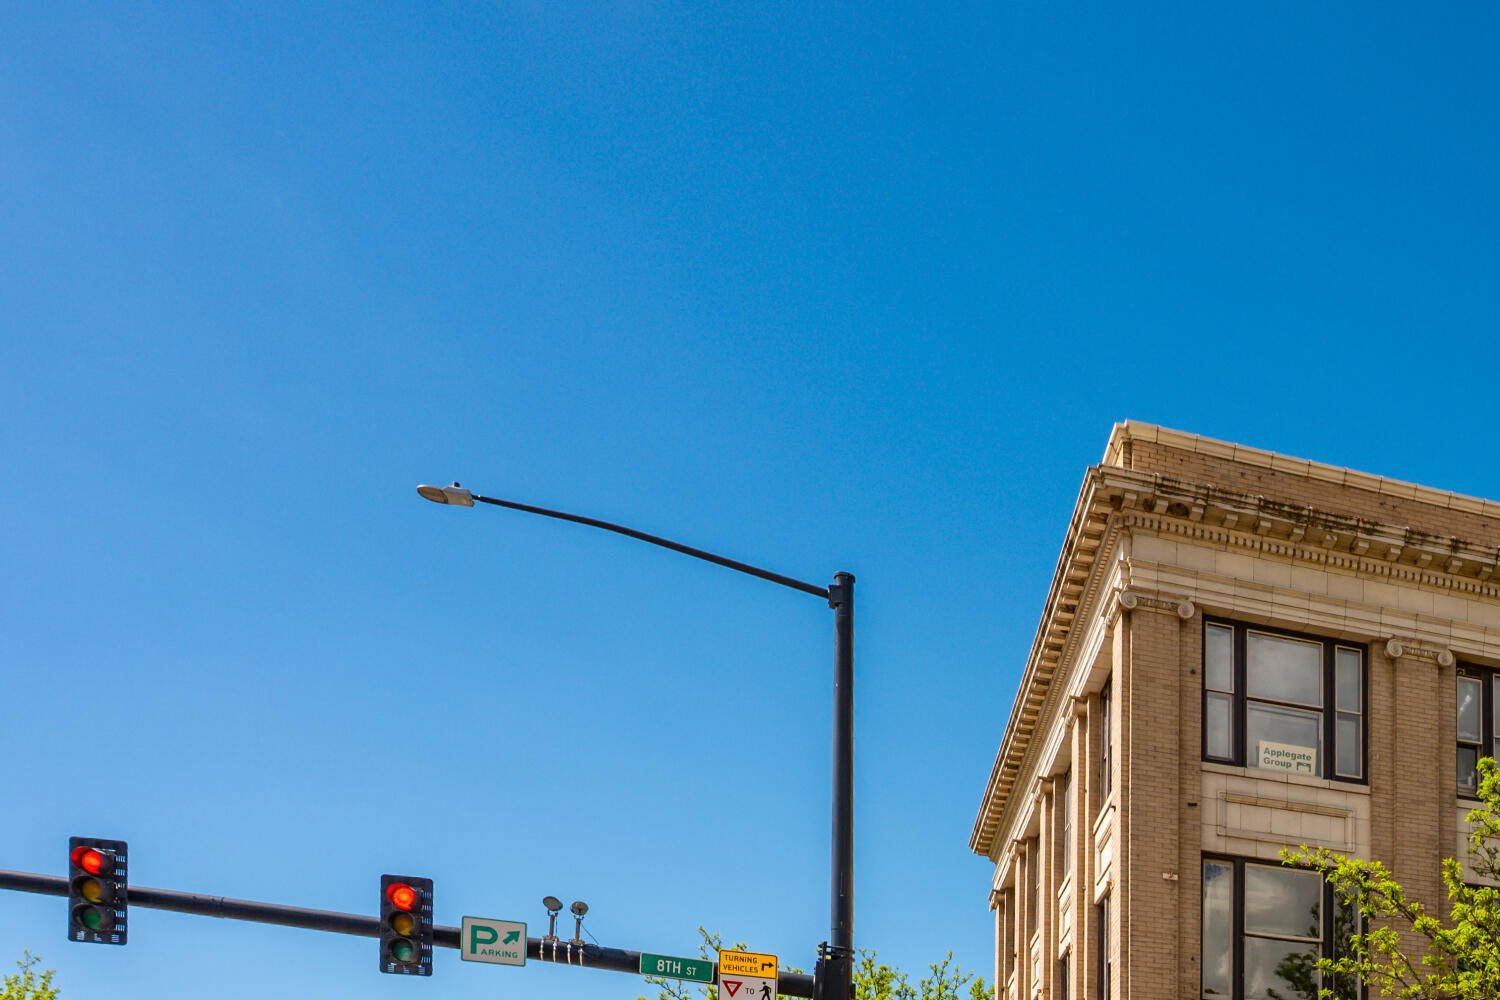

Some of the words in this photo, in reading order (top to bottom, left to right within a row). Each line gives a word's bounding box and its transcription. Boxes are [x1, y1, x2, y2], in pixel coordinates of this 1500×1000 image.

[1263, 747, 1312, 761] Applegate
[1263, 757, 1292, 769] Group
[724, 954, 758, 964] TURNING
[656, 959, 681, 974] 8TH
[686, 966, 697, 976] ST
[723, 964, 759, 974] VEHICLES
[745, 987, 755, 995] TO
